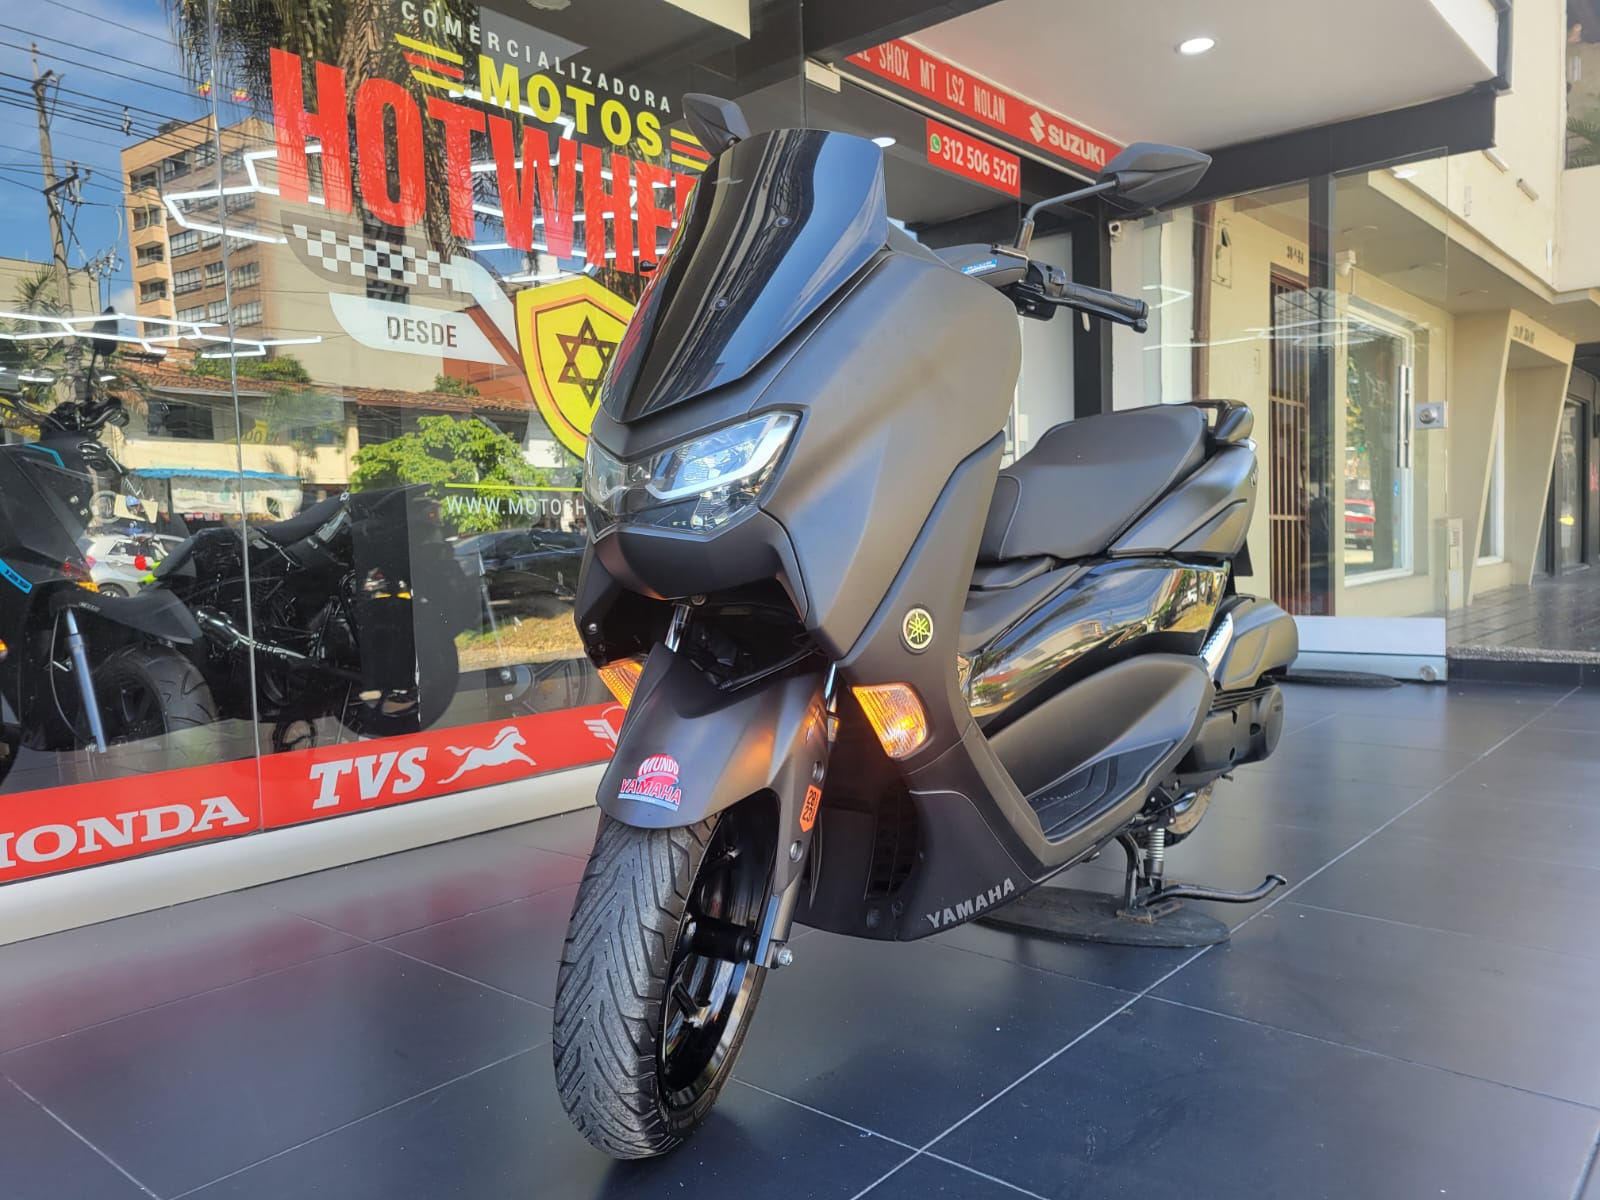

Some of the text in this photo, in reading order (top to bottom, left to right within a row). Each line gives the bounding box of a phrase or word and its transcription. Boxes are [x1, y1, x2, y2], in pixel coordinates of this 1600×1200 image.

[401, 0, 671, 114] COMERCIALIZADORA
[478, 54, 663, 157] MOTOS
[879, 42, 1106, 167] SHOX MT LS2 NOLAN SUZUKI
[270, 47, 697, 278] HOTWHE
[942, 136, 1018, 187] 312 506 5217
[386, 315, 458, 348] DESDE
[309, 746, 429, 810] TVS
[619, 778, 682, 806] YAMAHA
[638, 756, 679, 777] MUNDO
[926, 877, 1016, 929] YAMAHA
